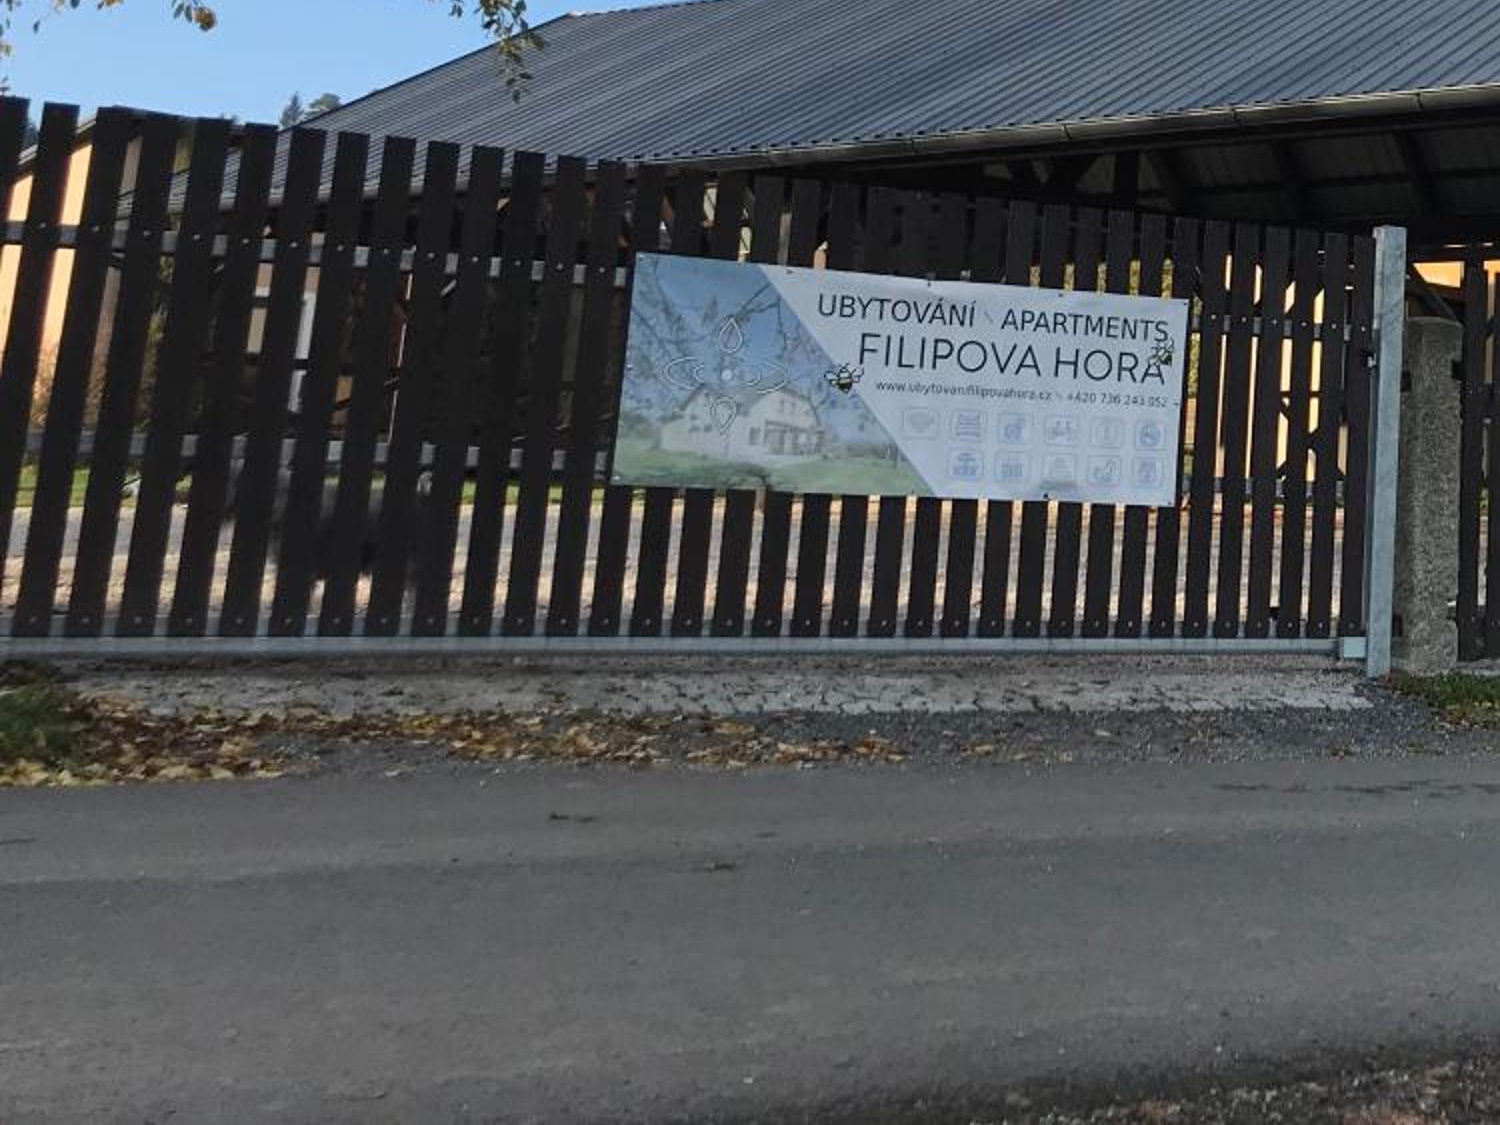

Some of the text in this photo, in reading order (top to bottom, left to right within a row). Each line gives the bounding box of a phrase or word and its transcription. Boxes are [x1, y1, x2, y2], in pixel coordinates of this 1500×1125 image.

[817, 292, 1170, 343] UBYTOVÁNÍ APARTMENTS
[858, 331, 1166, 386] FILIPOVA HORA
[1067, 391, 1097, 404] +420
